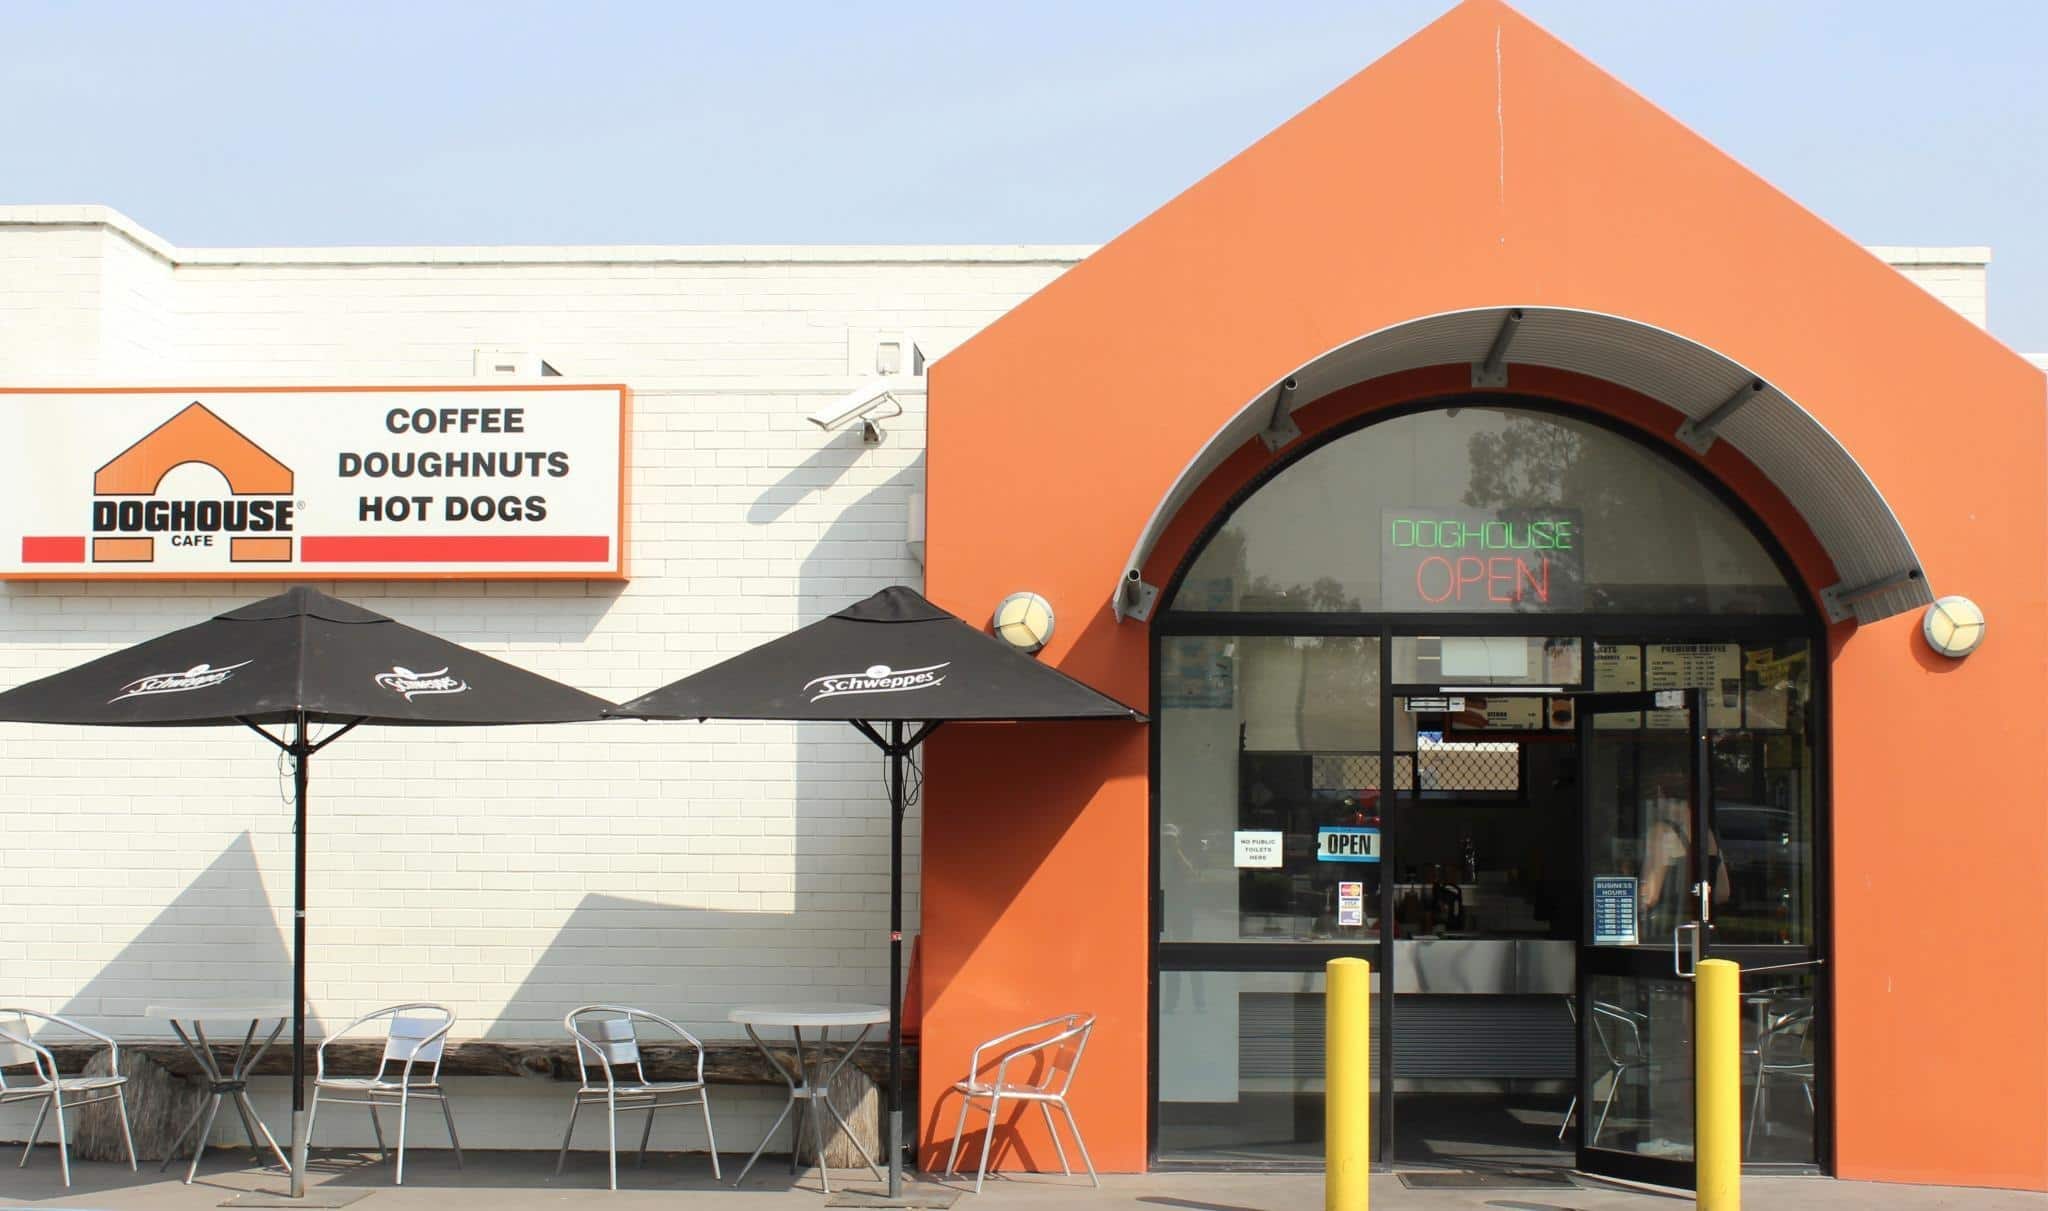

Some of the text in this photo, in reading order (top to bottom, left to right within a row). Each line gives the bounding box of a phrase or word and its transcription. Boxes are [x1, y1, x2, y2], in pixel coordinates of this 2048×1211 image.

[386, 408, 524, 434] COFFEE
[338, 451, 569, 478] DOUGHNUTS
[92, 500, 294, 532] DOGHOUSE
[359, 495, 547, 522] HOT DOGS
[171, 535, 213, 547] CAFE
[1392, 519, 1574, 550] DOGHOUSE
[1416, 556, 1550, 603] OPEN
[819, 672, 935, 694] Schweppes
[1327, 833, 1371, 855] OPEN
